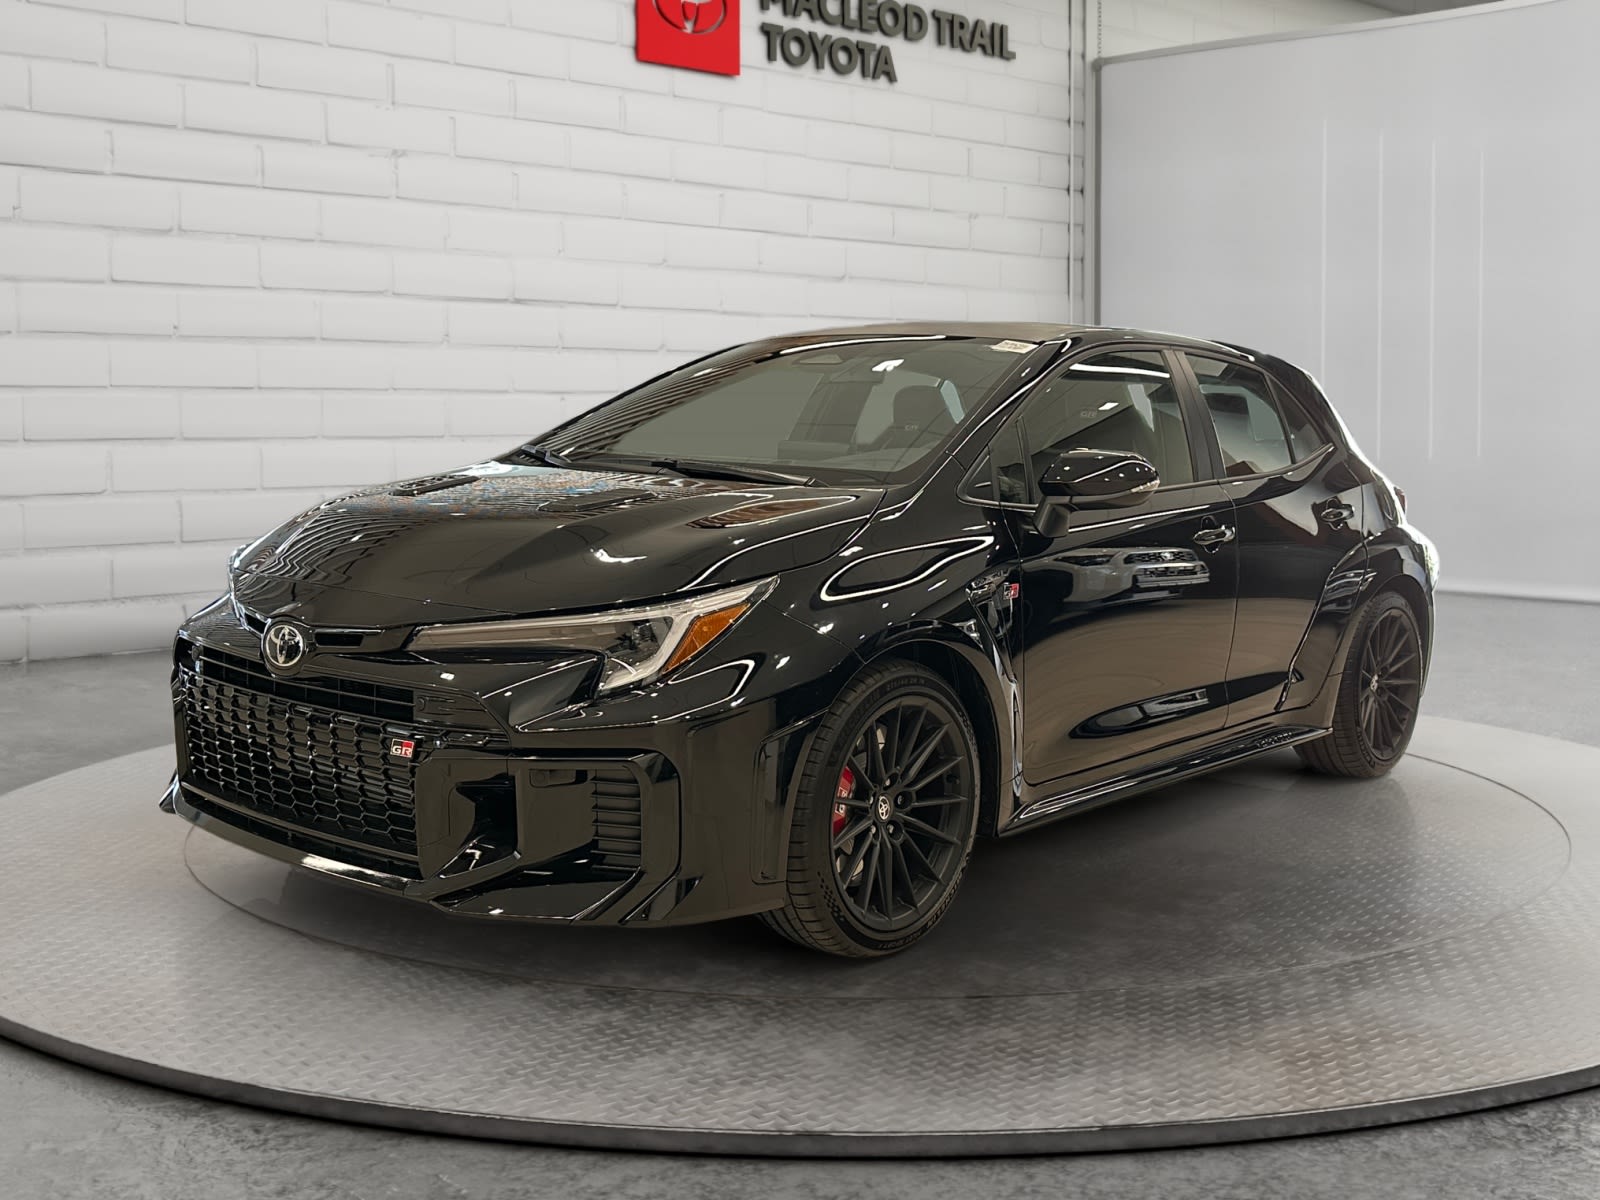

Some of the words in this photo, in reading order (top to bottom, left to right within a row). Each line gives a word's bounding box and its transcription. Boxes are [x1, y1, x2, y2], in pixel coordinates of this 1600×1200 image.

[760, 22, 898, 83] TOYOTA
[931, 9, 1016, 61] TRAIL
[392, 745, 412, 756] GR
